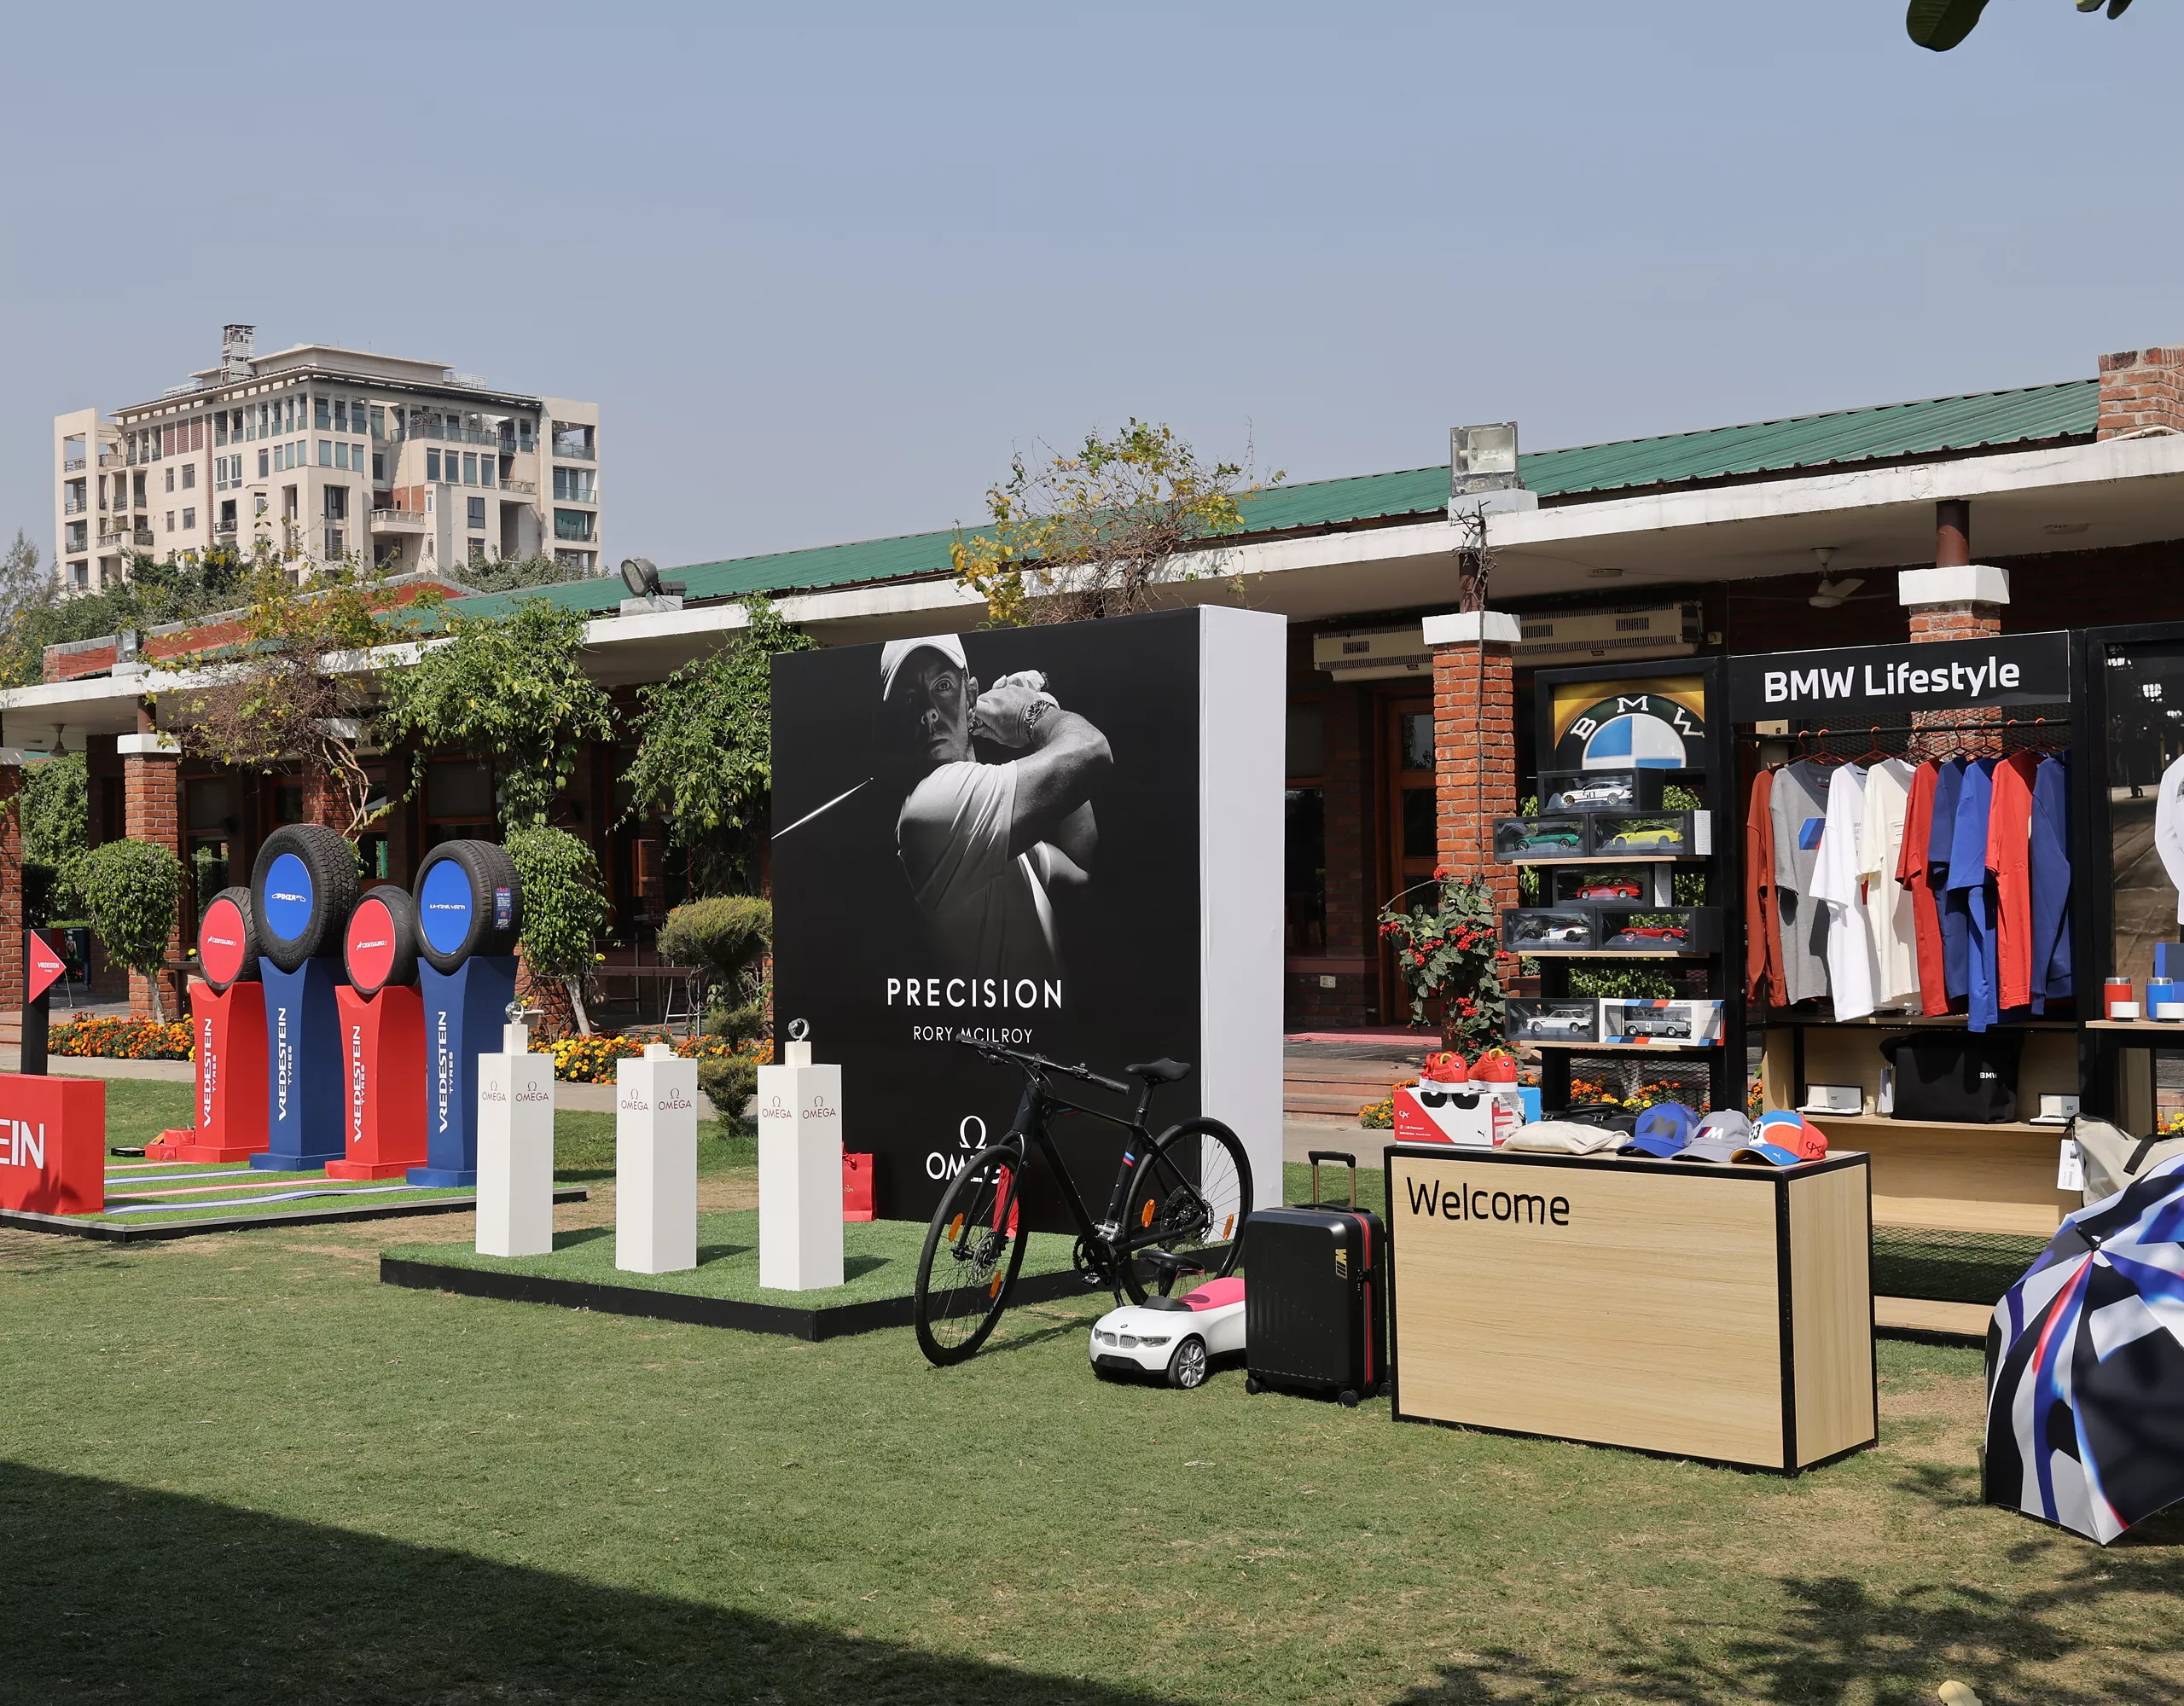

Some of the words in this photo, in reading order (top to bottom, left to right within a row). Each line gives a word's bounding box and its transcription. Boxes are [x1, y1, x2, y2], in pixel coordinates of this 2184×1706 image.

[1764, 666, 1855, 703] BMW
[1865, 656, 2020, 697] Lifestyle
[887, 978, 1062, 1009] PRECISION
[913, 1025, 953, 1042] RORY
[204, 1018, 212, 1128] VREDESTEIN
[278, 1007, 287, 1122] VREDESTEIN
[438, 1011, 448, 1134] VREDESTEIN
[352, 1025, 362, 1143] VREDESTEIN
[482, 1091, 507, 1102] OMEGA
[515, 1092, 549, 1102] OMEGA
[621, 1100, 649, 1111] OMEGA
[658, 1099, 693, 1111] OMEGA
[762, 1109, 793, 1119] OMEGA
[802, 1107, 837, 1120] OMEGA
[1406, 1176, 1570, 1226] Welcome
